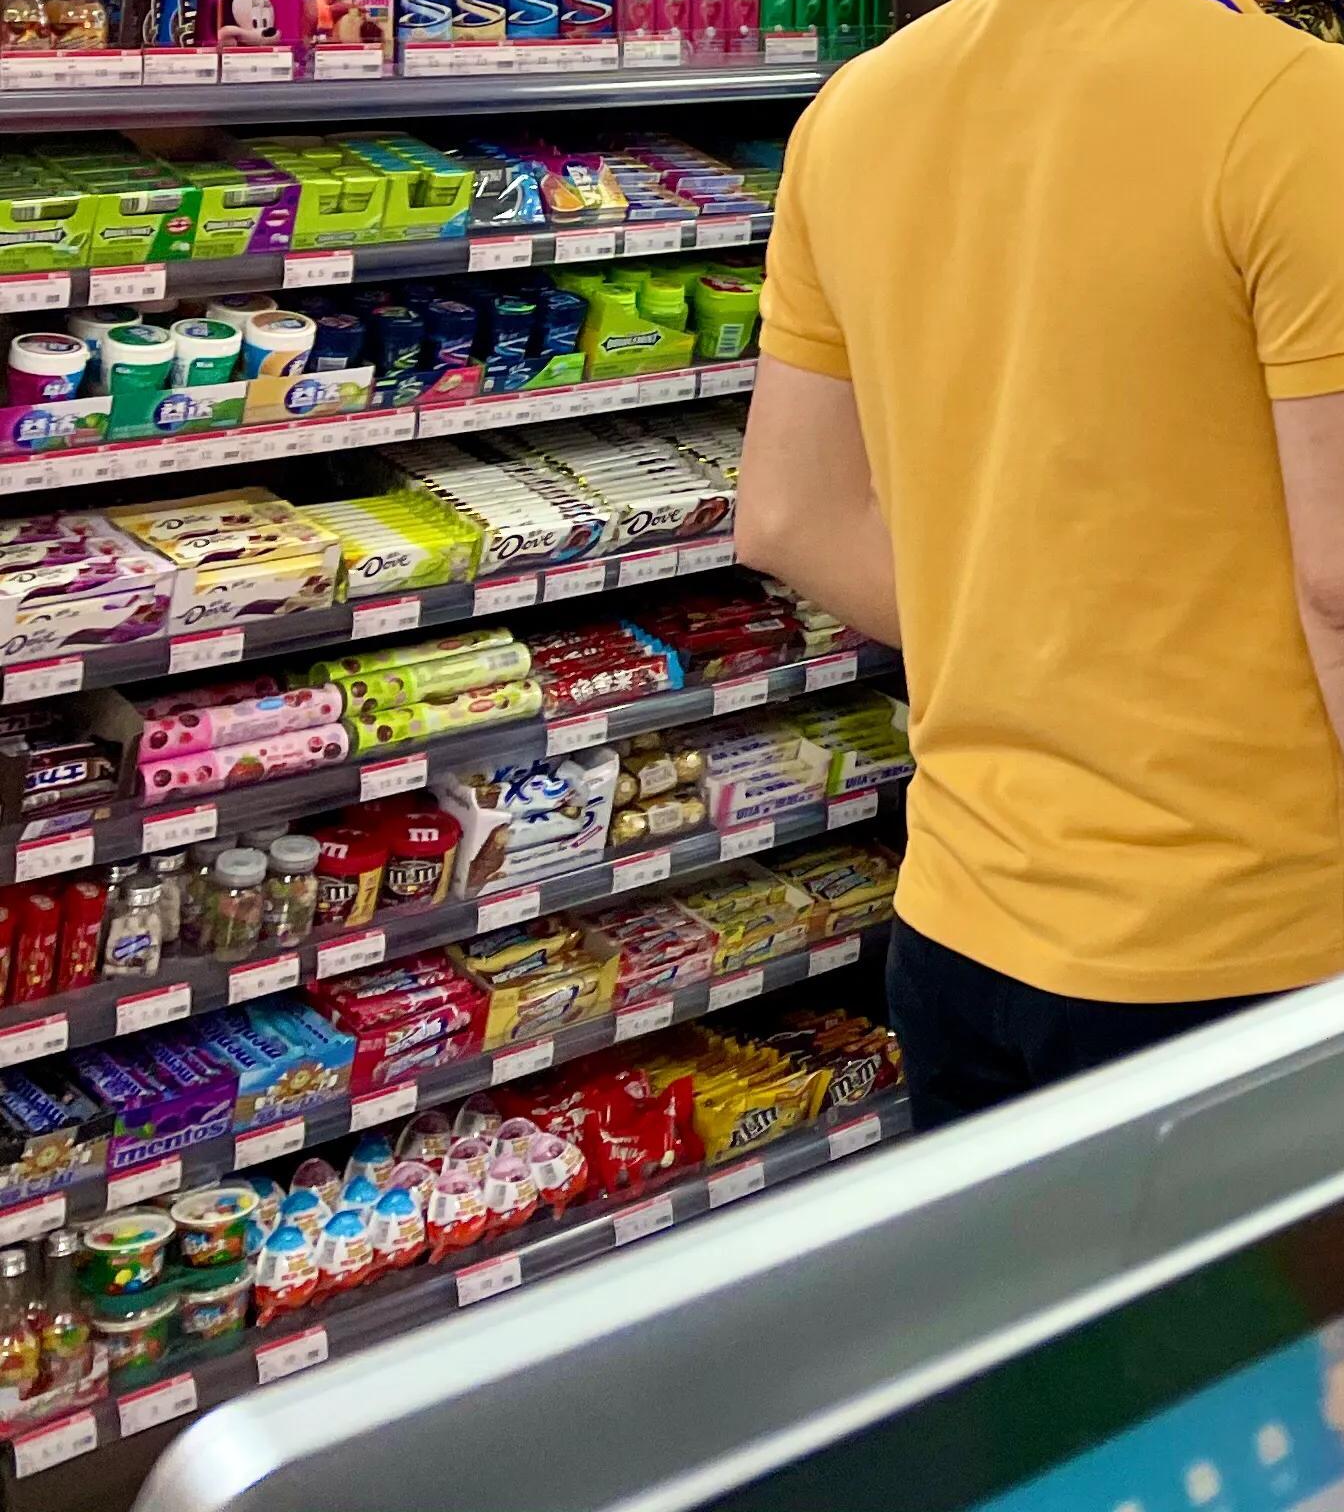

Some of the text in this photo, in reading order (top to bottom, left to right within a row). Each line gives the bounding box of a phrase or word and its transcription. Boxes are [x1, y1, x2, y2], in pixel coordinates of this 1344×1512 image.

[622, 506, 682, 537] Dove
[497, 531, 556, 561] Dove
[356, 553, 412, 579] Dove
[408, 828, 440, 843] m
[322, 842, 349, 859] m
[113, 1120, 231, 1168] mentos
